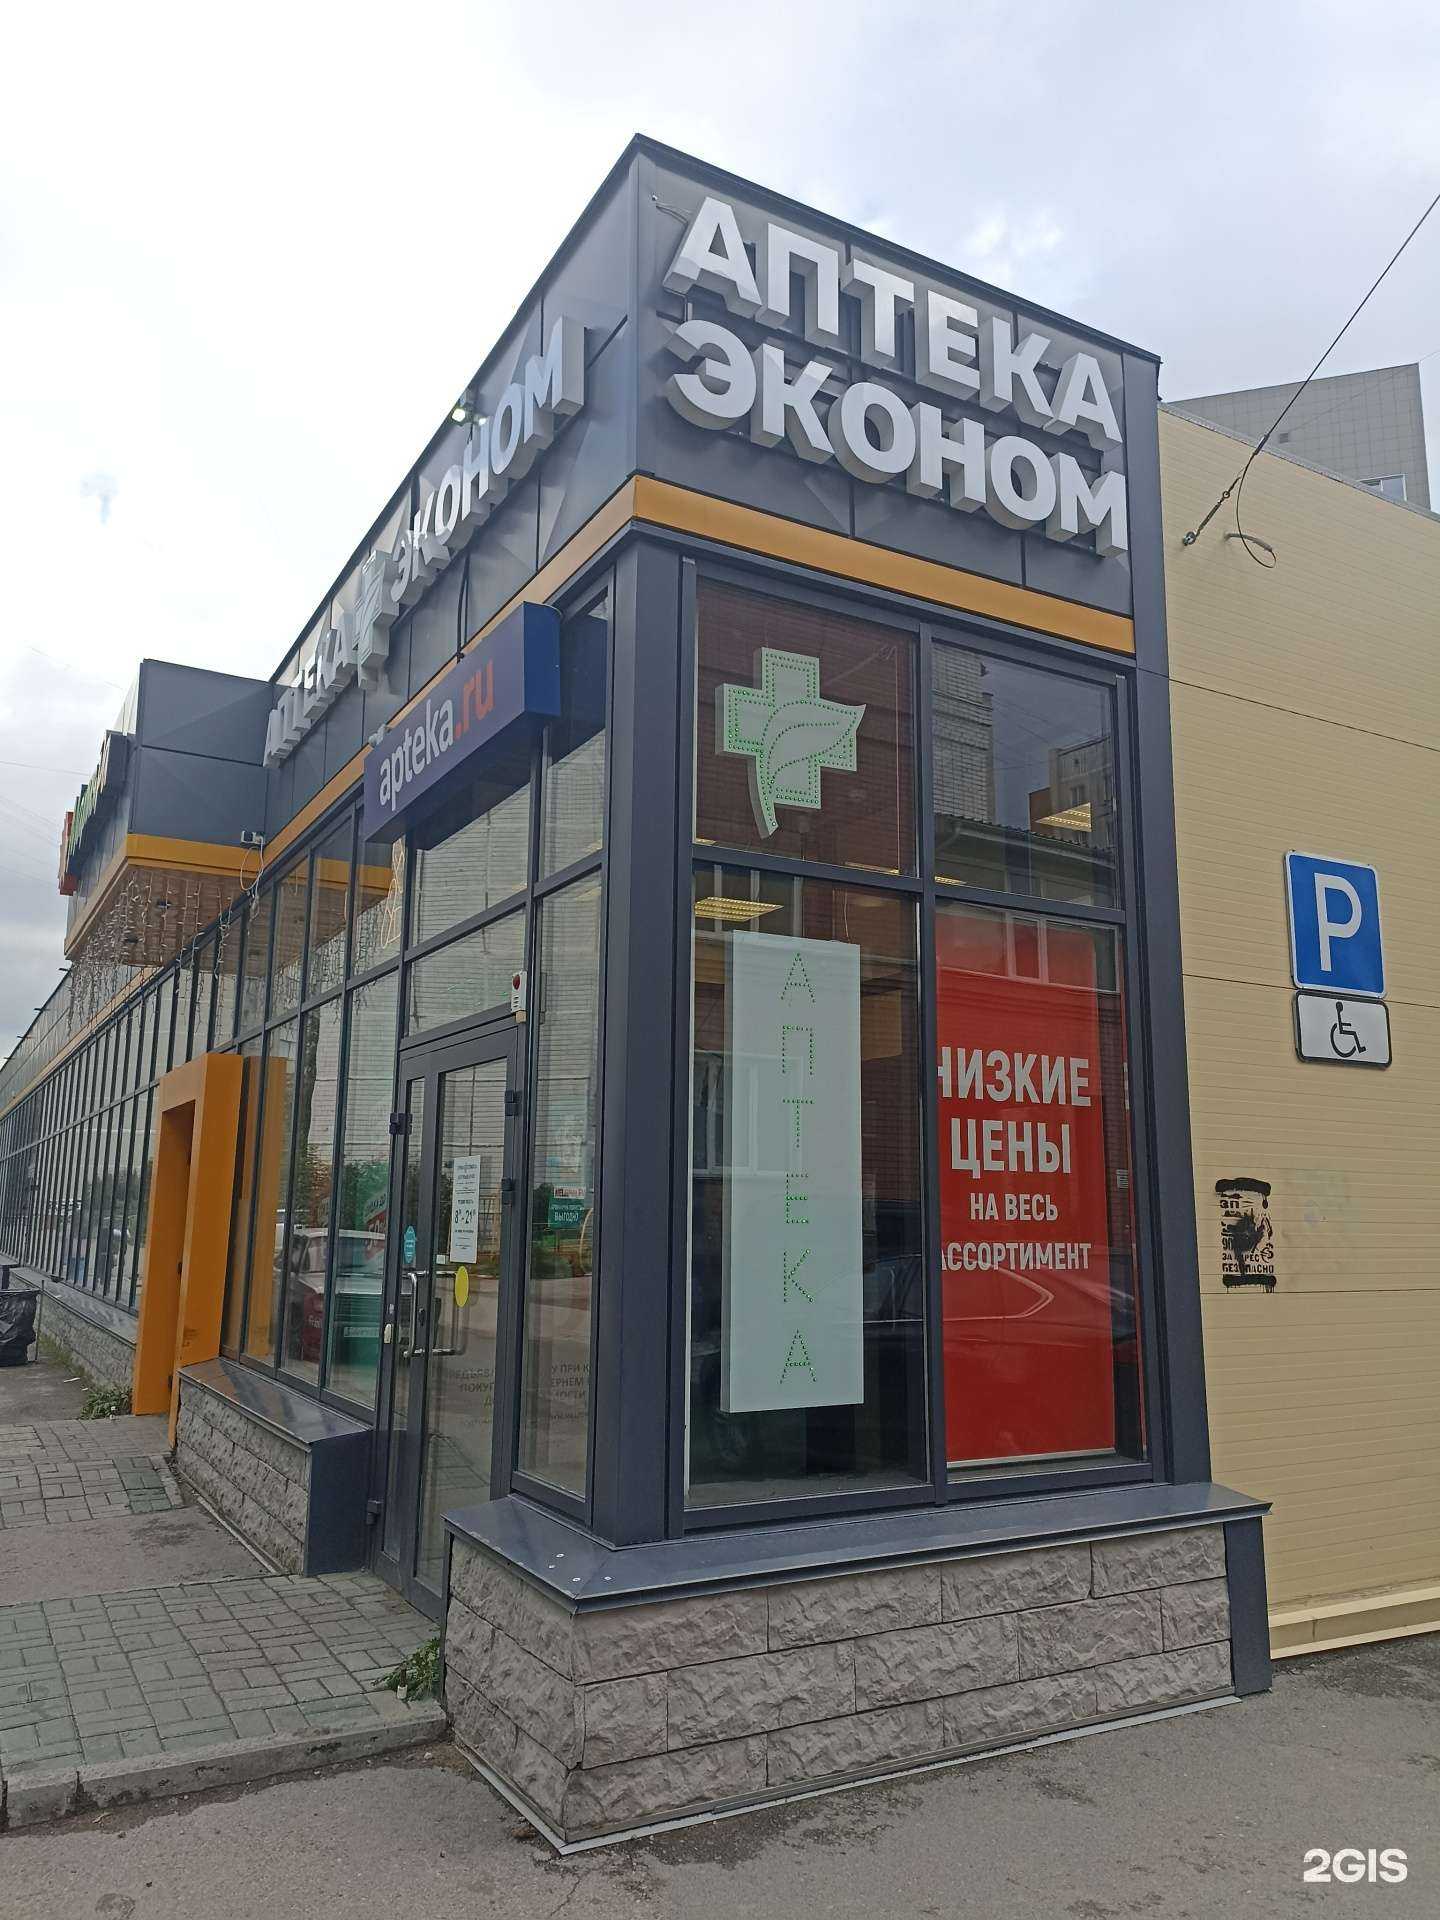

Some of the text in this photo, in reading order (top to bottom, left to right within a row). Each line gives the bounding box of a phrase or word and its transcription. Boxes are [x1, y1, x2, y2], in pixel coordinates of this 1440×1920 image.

[662, 196, 1123, 452] АПТЕКА
[391, 315, 584, 604] ЭКОНОМ
[665, 318, 1129, 560] ЭКОНОМ
[379, 658, 495, 812] apteka.ru
[1314, 872, 1363, 972] P
[779, 952, 816, 1384] АПТЕКА
[950, 1117, 1072, 1179] ЦЕНЫ
[969, 1193, 1059, 1222] НА ВЕСЬ
[1222, 1263, 1275, 1274] БЕЗПАСНО
